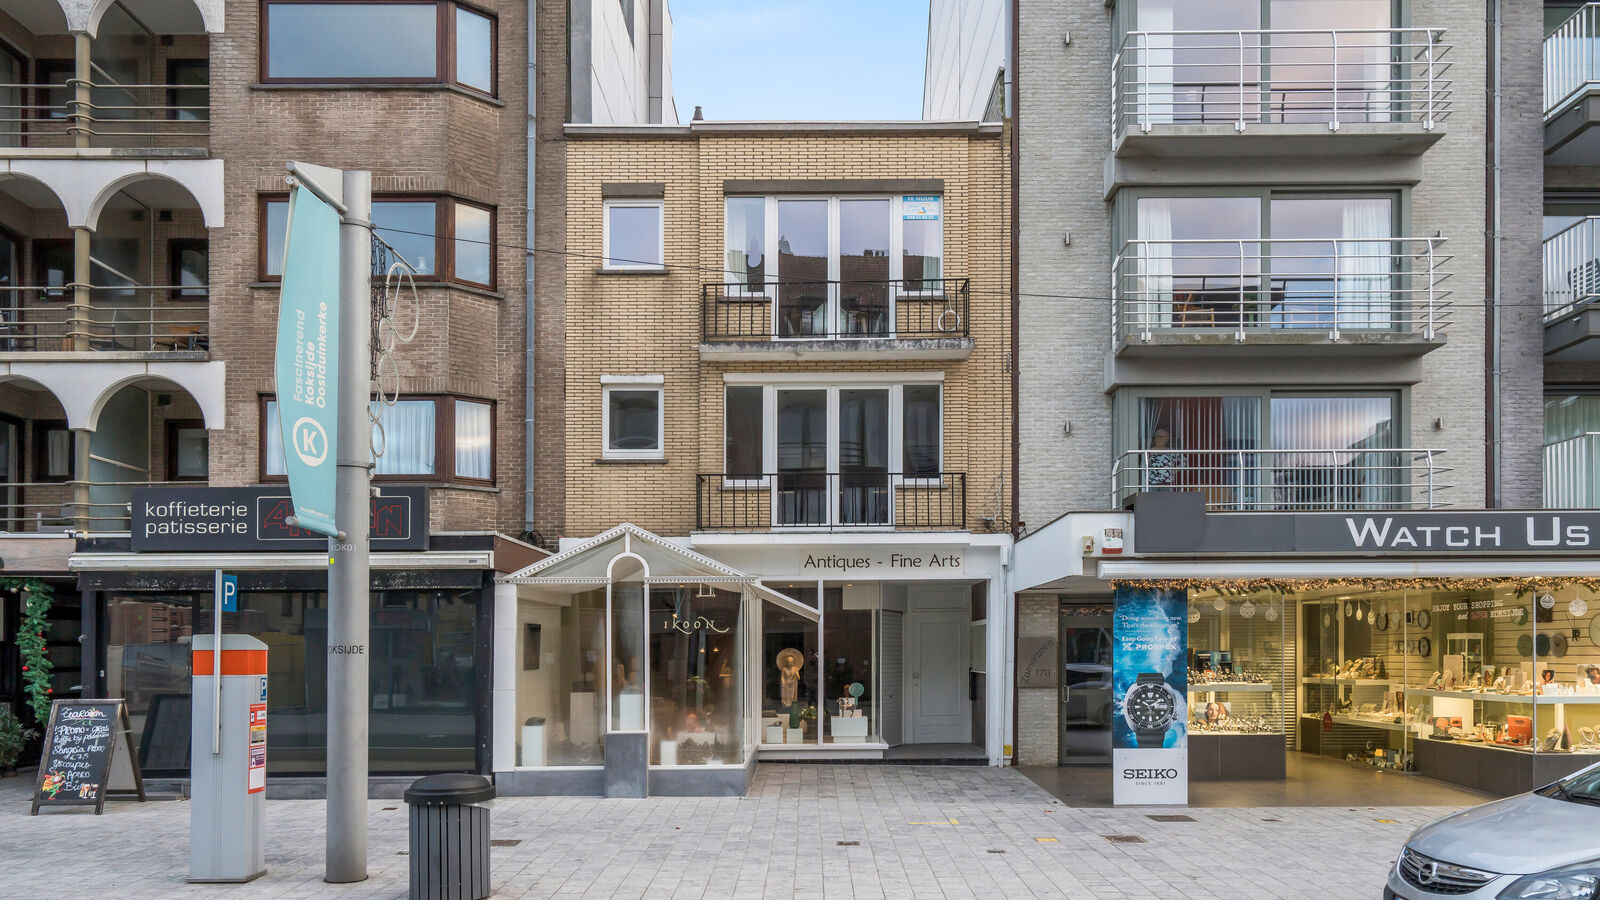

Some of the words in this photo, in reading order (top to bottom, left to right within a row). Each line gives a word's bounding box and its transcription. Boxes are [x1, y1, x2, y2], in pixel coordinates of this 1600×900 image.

[293, 309, 305, 402] Fascinerend
[316, 302, 328, 409] Oostduinkerke
[304, 341, 316, 405] Koksijde
[303, 428, 318, 455] K
[145, 501, 248, 517] koffieterie
[145, 518, 248, 538] patisserie
[804, 554, 871, 572] Antiques
[891, 553, 922, 568] Fine
[928, 553, 961, 568] Arts
[224, 581, 235, 605] P
[1432, 603, 1451, 612] ENJOY
[1453, 602, 1468, 611] YOUR
[1471, 600, 1504, 609] SHOPPING
[1490, 608, 1524, 618] KOKSIJDE
[1123, 769, 1178, 779] SEIKO
